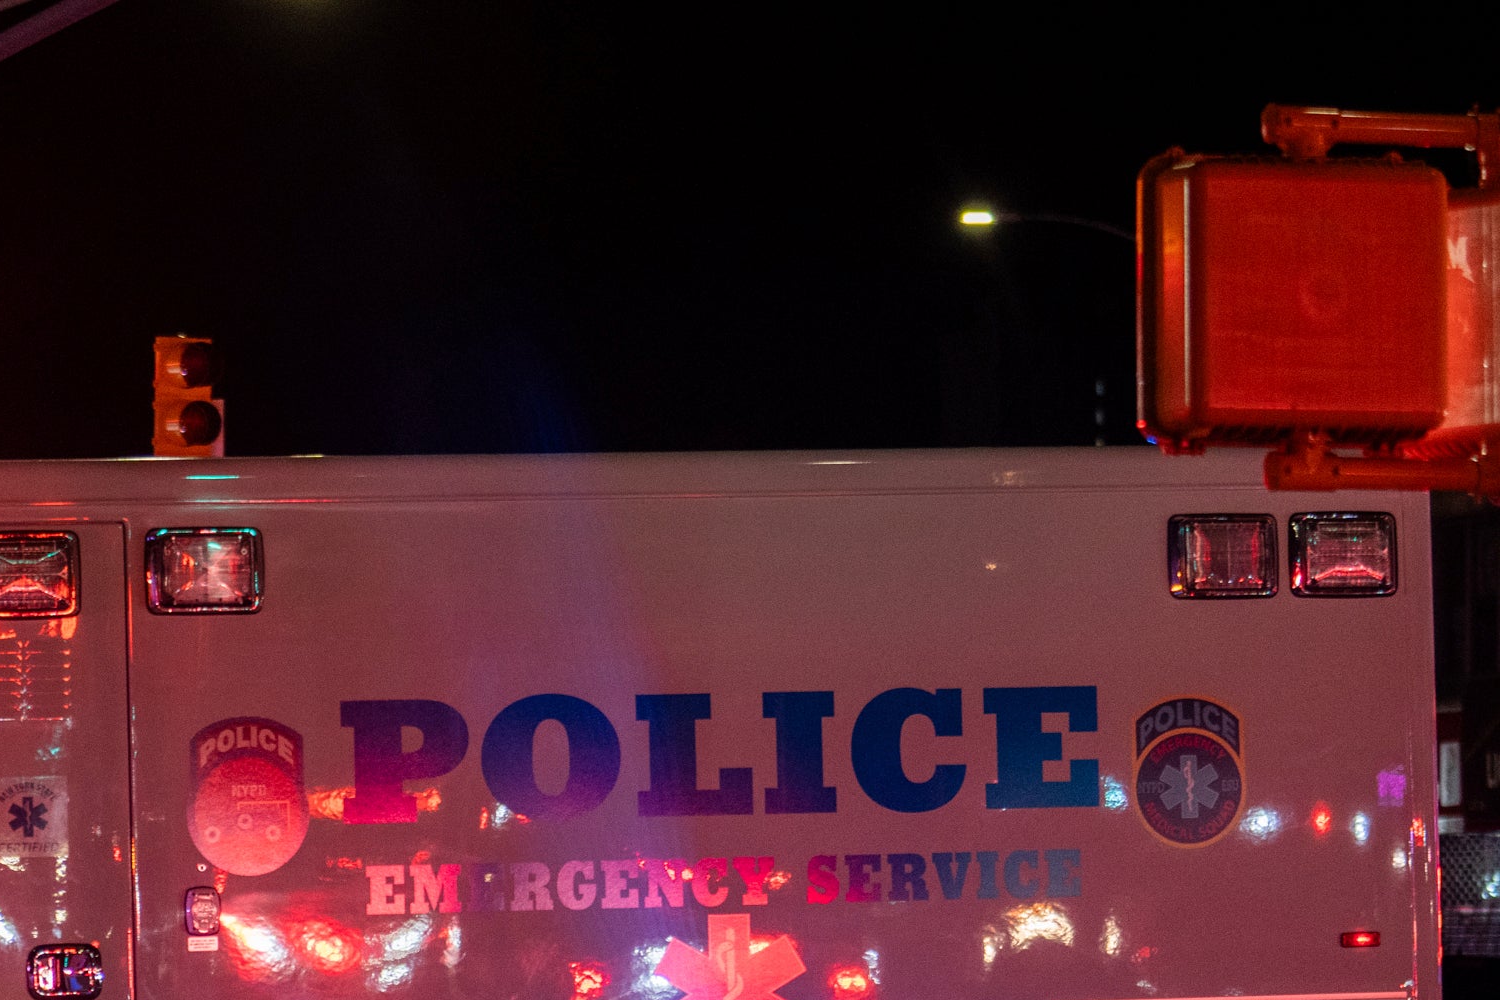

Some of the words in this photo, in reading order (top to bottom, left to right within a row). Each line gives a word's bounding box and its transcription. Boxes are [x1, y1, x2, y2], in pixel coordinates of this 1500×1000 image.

[200, 726, 295, 768] POLICE
[1139, 701, 1238, 749] POLICE
[340, 684, 1100, 826] POLICE
[1150, 734, 1226, 764] EMERGENCY
[231, 784, 268, 797] NYPD
[364, 856, 775, 916] EMERGENCY
[806, 848, 1082, 905] SERVICE
